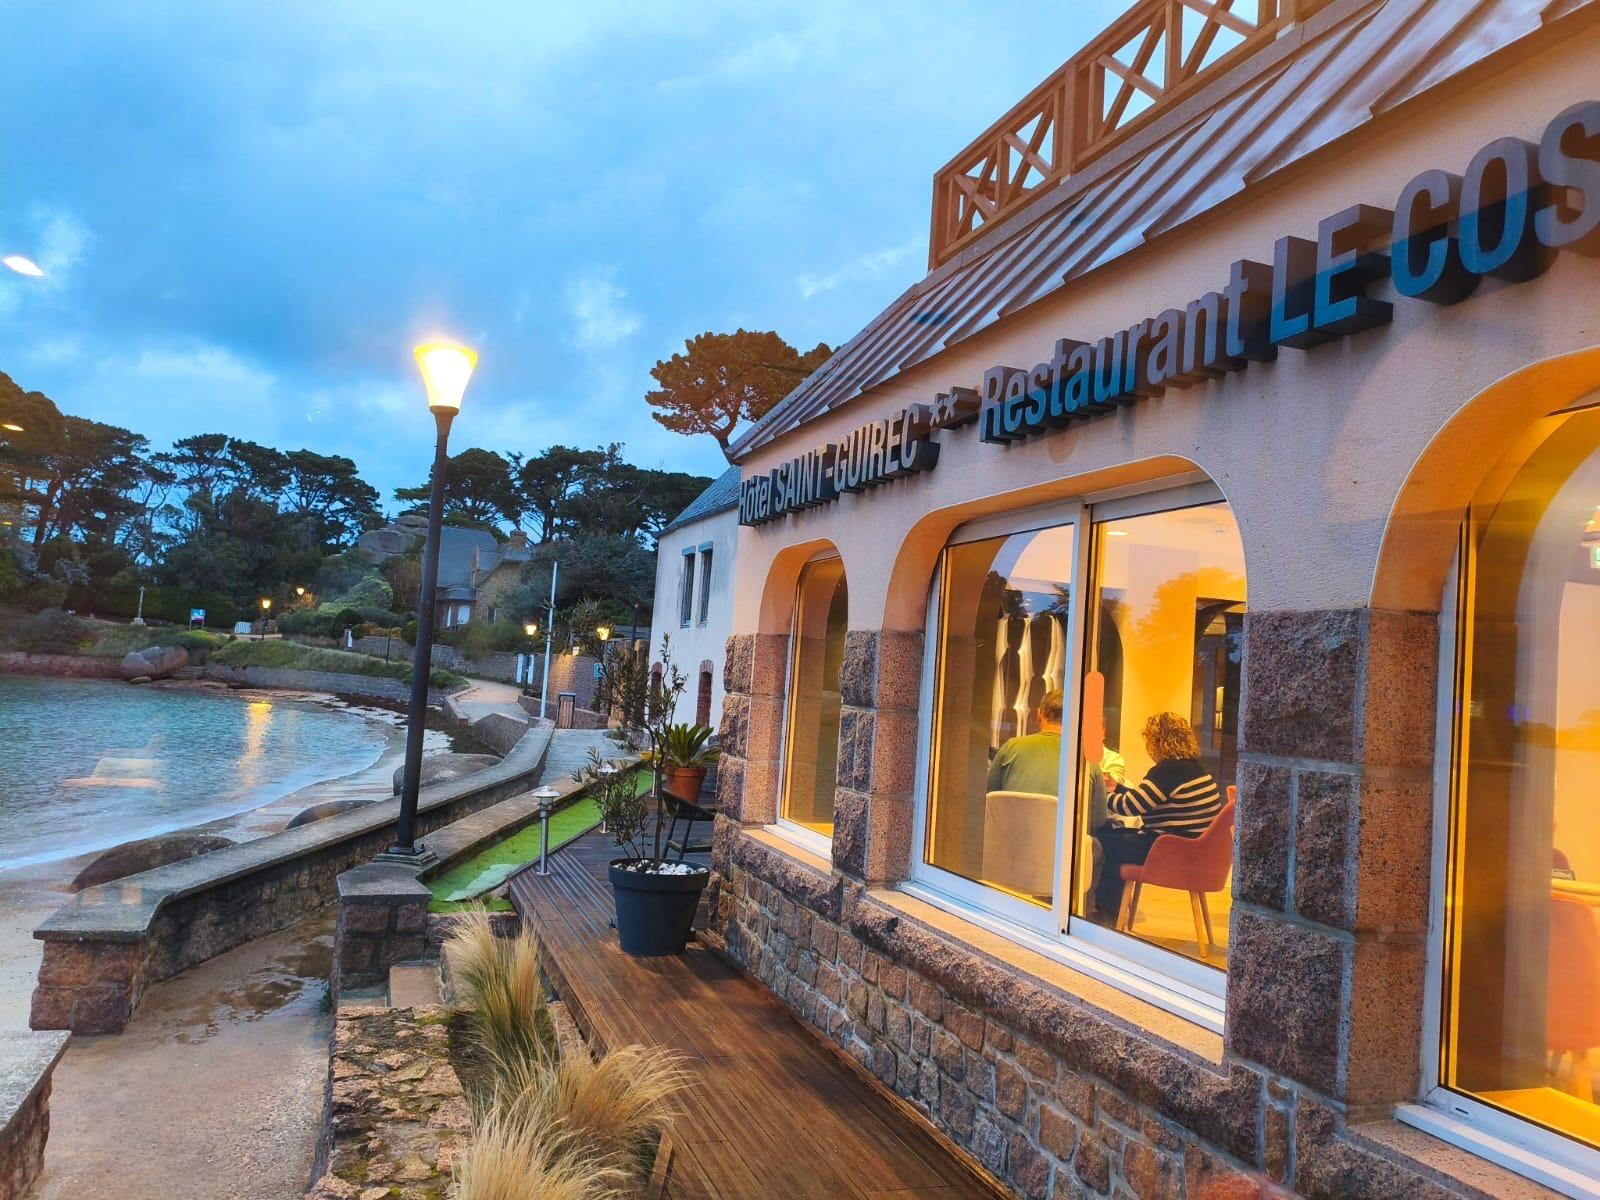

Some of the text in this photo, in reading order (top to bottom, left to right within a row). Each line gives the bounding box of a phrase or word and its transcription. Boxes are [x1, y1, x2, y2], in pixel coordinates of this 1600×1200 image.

[739, 100, 1600, 525] Hôtel SAINT-GUIREC Restaurant LE COS
